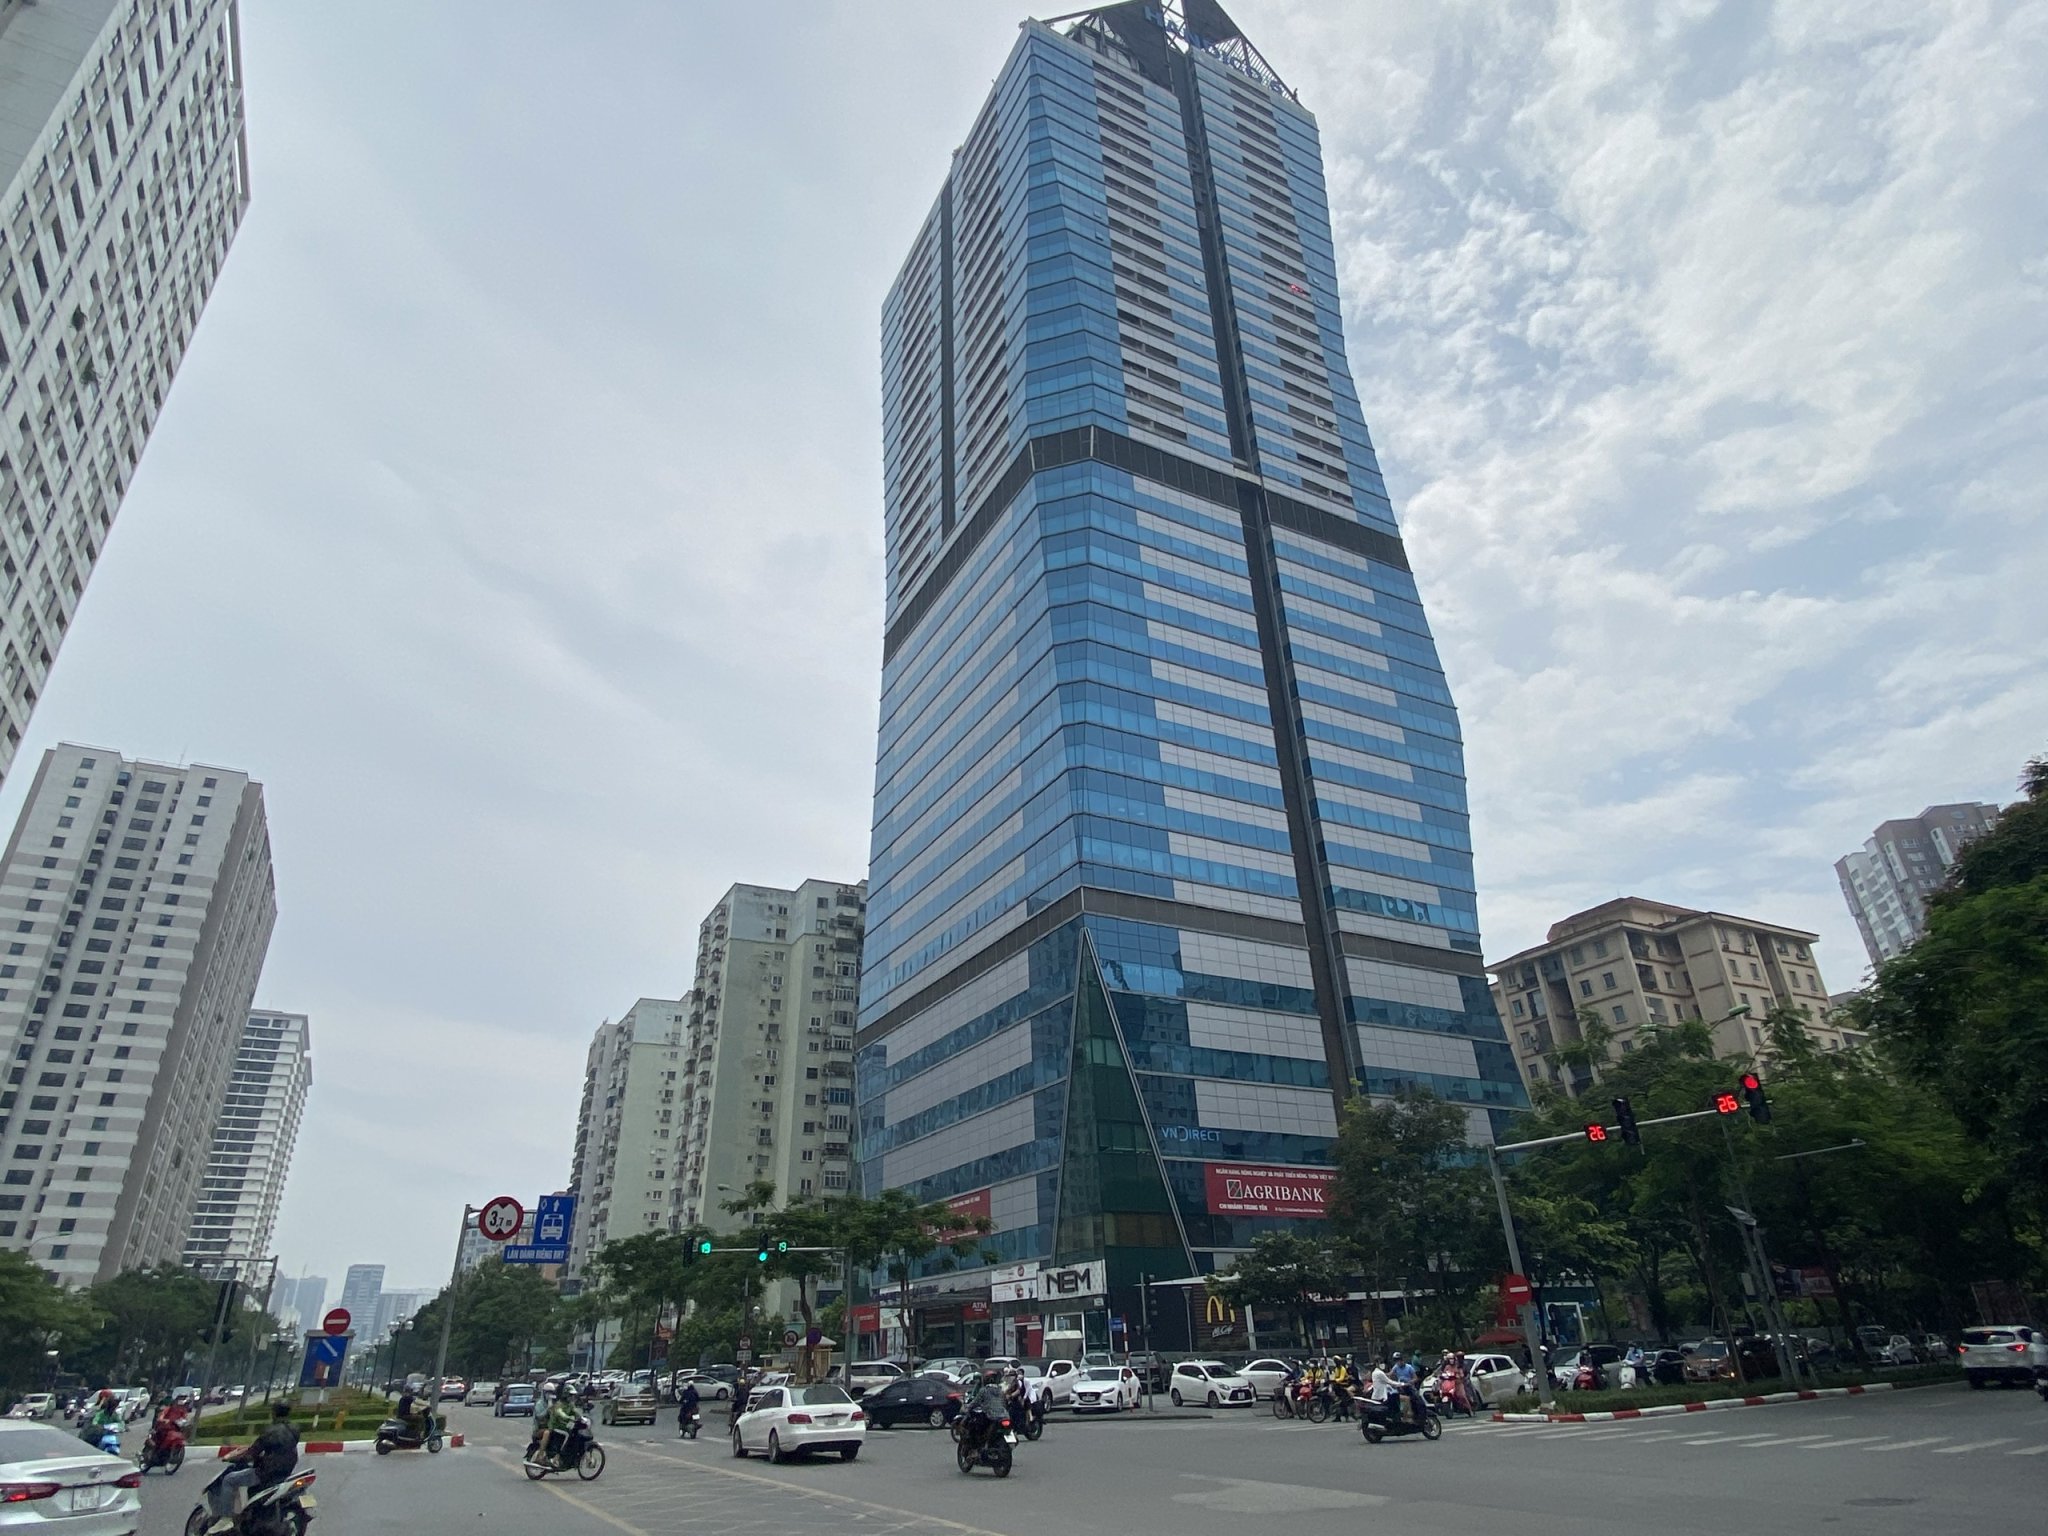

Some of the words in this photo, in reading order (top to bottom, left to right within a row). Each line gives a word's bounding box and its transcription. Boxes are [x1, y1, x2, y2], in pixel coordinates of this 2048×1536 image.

[1717, 1095, 1738, 1113] 26
[1588, 1126, 1606, 1141] 26
[1243, 1185, 1325, 1203] AGRIBANK
[1046, 1267, 1092, 1295] NEM
[971, 1301, 988, 1309] ATM
